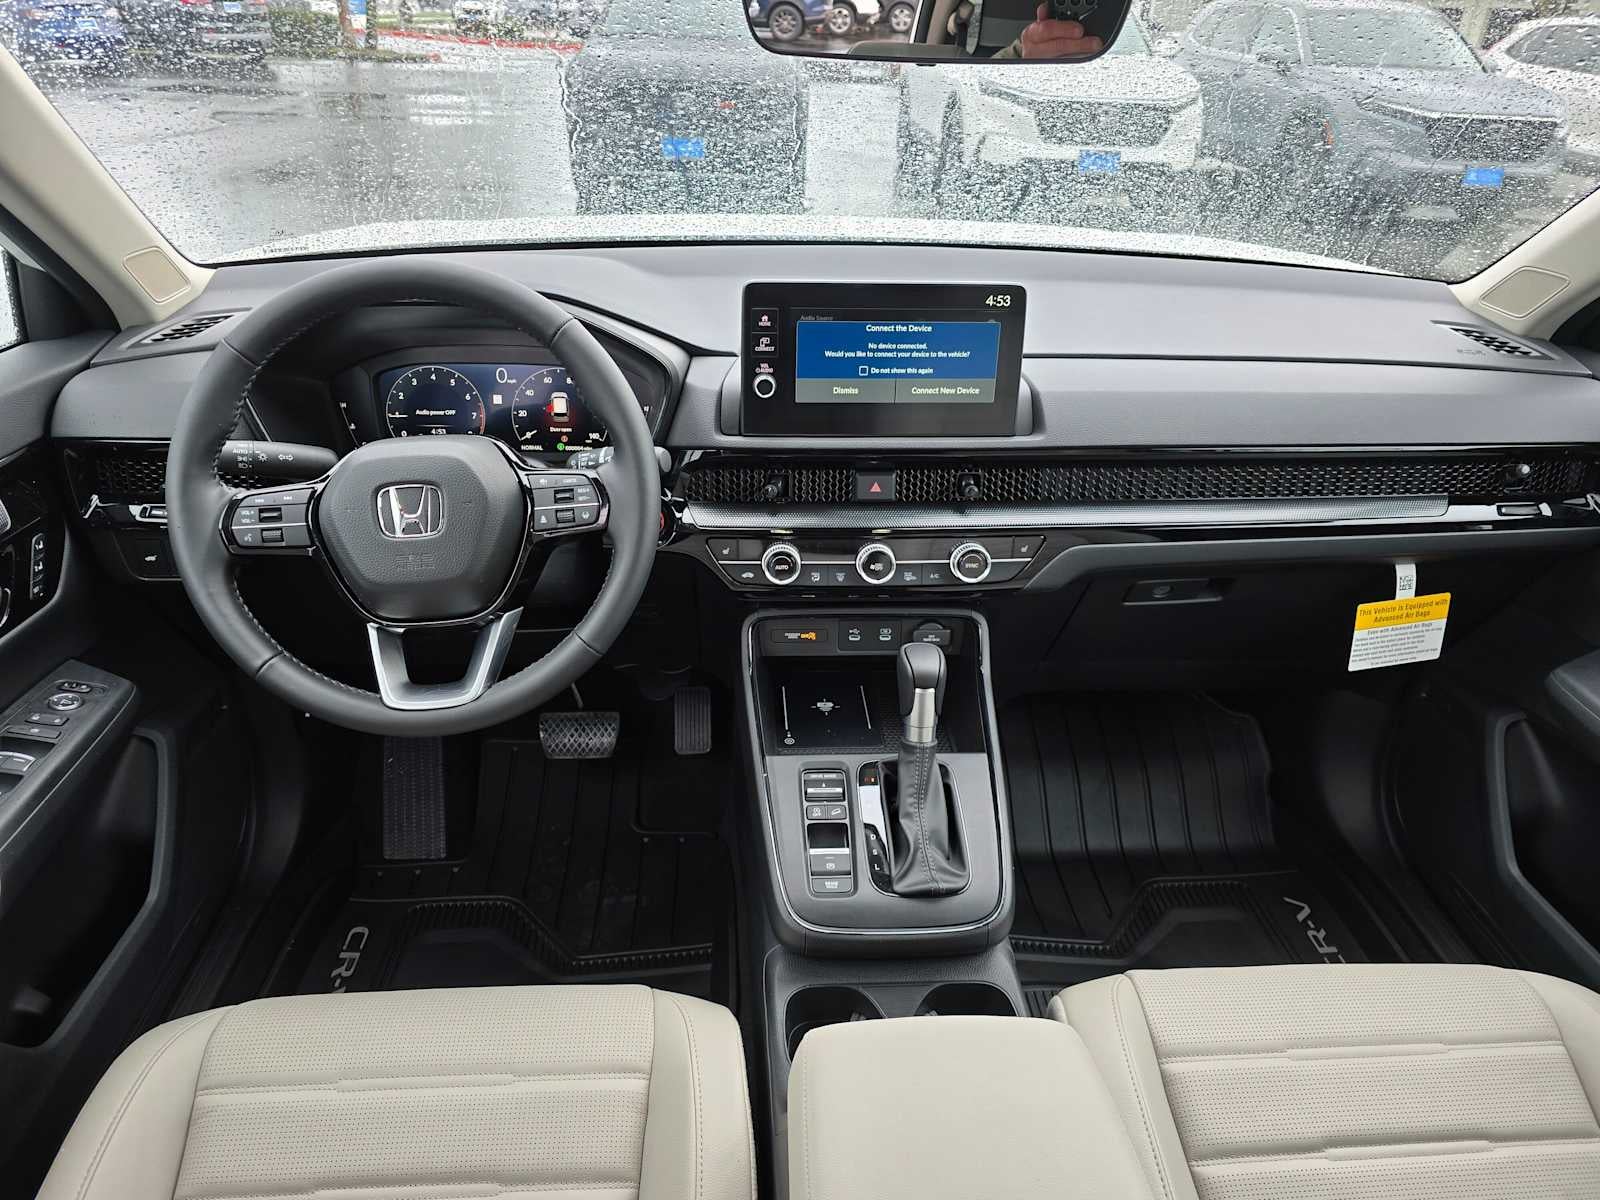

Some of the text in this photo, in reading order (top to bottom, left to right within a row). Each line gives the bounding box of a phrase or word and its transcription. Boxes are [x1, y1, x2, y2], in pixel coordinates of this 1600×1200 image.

[985, 295, 1011, 307] 4:53
[844, 351, 855, 359] you
[897, 351, 910, 359] your
[495, 367, 508, 384] 0
[918, 367, 934, 376] again
[430, 373, 437, 381] 4
[411, 378, 418, 386] 3
[525, 389, 534, 397] 40
[833, 387, 859, 395] Dismiss
[911, 387, 980, 395] Connect New Device
[398, 392, 405, 400] 2
[465, 393, 471, 401] 6
[471, 412, 477, 420] 7
[1359, 609, 1372, 617] This
[1373, 606, 1397, 615] Vehicle
[1405, 600, 1434, 611] Equipped
[1374, 614, 1404, 624] Advanced
[1405, 612, 1415, 620] Air
[330, 926, 369, 994] CR-
